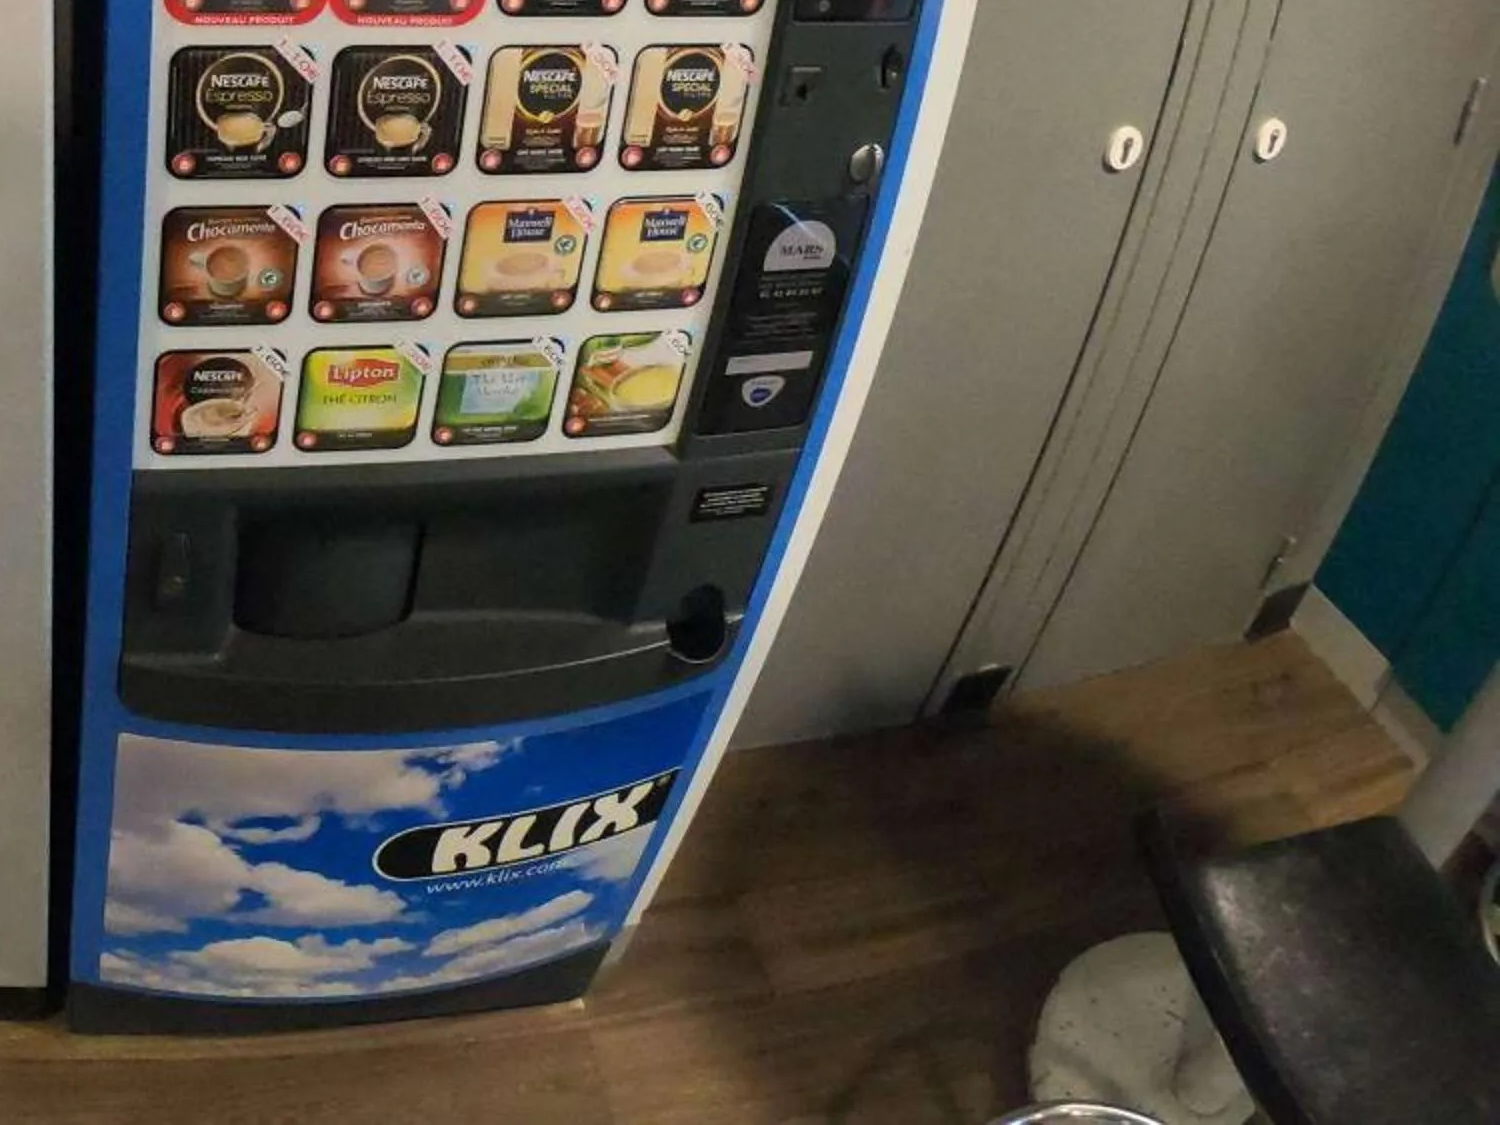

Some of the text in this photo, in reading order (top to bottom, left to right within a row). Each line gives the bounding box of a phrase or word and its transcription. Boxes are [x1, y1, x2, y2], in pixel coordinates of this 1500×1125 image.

[195, 15, 295, 25] NOUVEAU PRODUIT
[357, 16, 453, 26] NOUVEAU PRODUIT
[205, 88, 274, 104] Espresso
[367, 90, 431, 106] Espresso
[508, 216, 554, 228] Maxwell
[644, 215, 686, 228] Maxwell
[781, 244, 825, 256] MARS
[333, 365, 395, 383] Lipton
[431, 781, 655, 874] KLIX
[426, 858, 567, 895] www.klix.com
